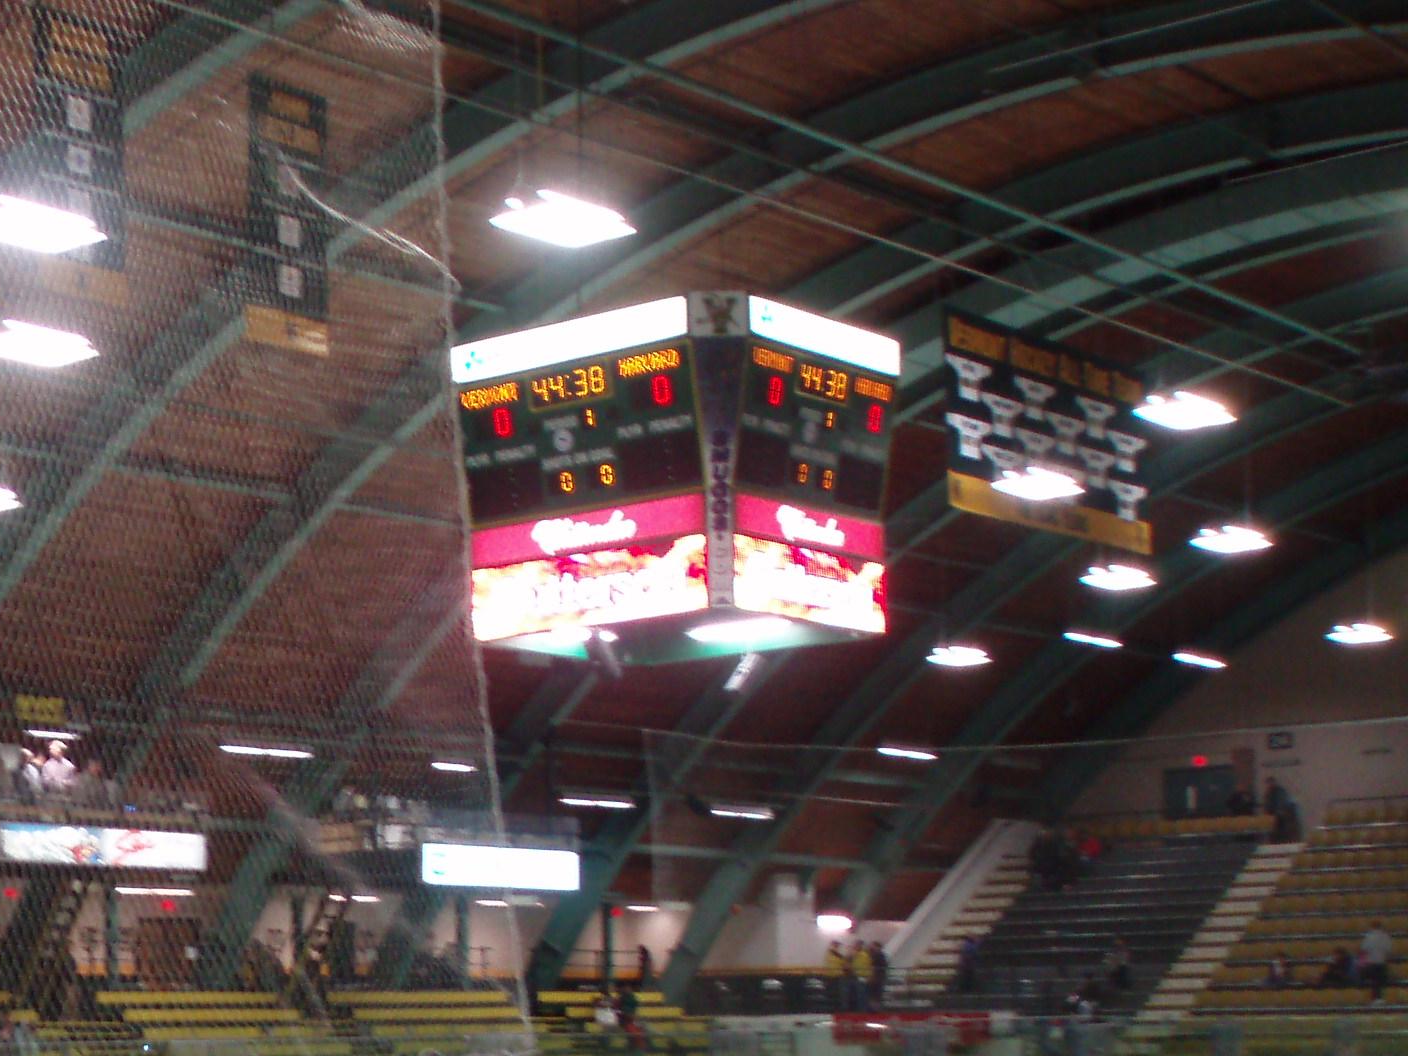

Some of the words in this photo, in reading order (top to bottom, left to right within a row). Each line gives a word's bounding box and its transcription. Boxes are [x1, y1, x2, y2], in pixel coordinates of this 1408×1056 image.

[617, 348, 681, 377] HARVARD
[460, 382, 519, 410] VERMONT
[531, 365, 606, 402] 44:38
[651, 374, 673, 406] 0
[492, 407, 513, 438] 0
[584, 407, 597, 428] 1
